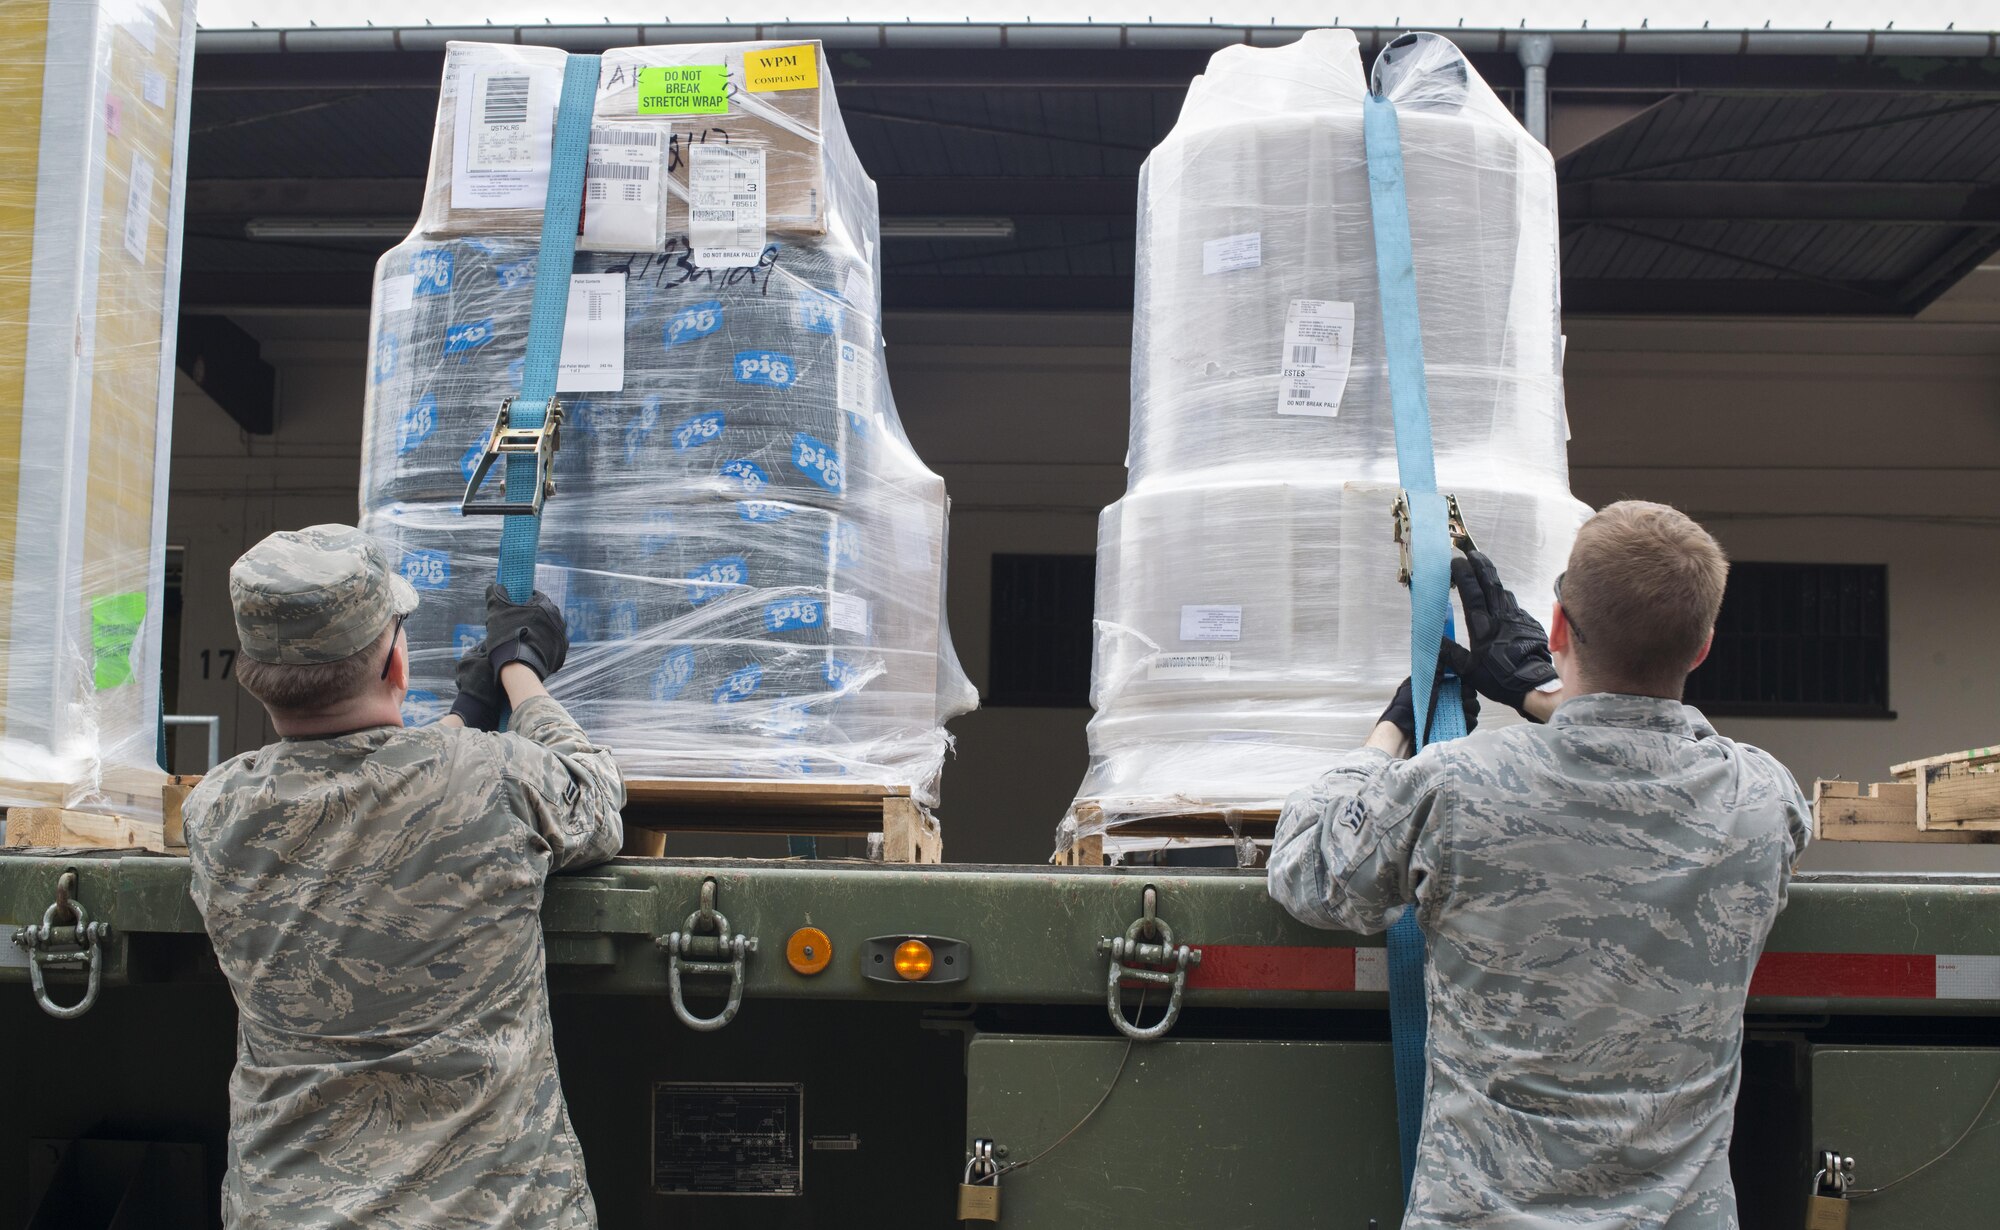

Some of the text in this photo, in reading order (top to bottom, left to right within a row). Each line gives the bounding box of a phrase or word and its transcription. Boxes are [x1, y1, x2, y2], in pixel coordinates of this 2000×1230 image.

[759, 55, 798, 69] WPM
[664, 70, 702, 82] DO NOT
[754, 74, 806, 85] COMPLIANT
[665, 83, 701, 94] BREAK
[643, 95, 723, 107] STRETCH WRAP
[746, 183, 757, 192] 3
[667, 309, 716, 342] pig
[740, 354, 790, 383] pig
[1284, 369, 1306, 377] ESTES
[677, 418, 720, 450] pig
[798, 443, 841, 487] pig
[405, 554, 445, 585] pig
[771, 600, 818, 629] pig
[201, 649, 236, 680] 17
